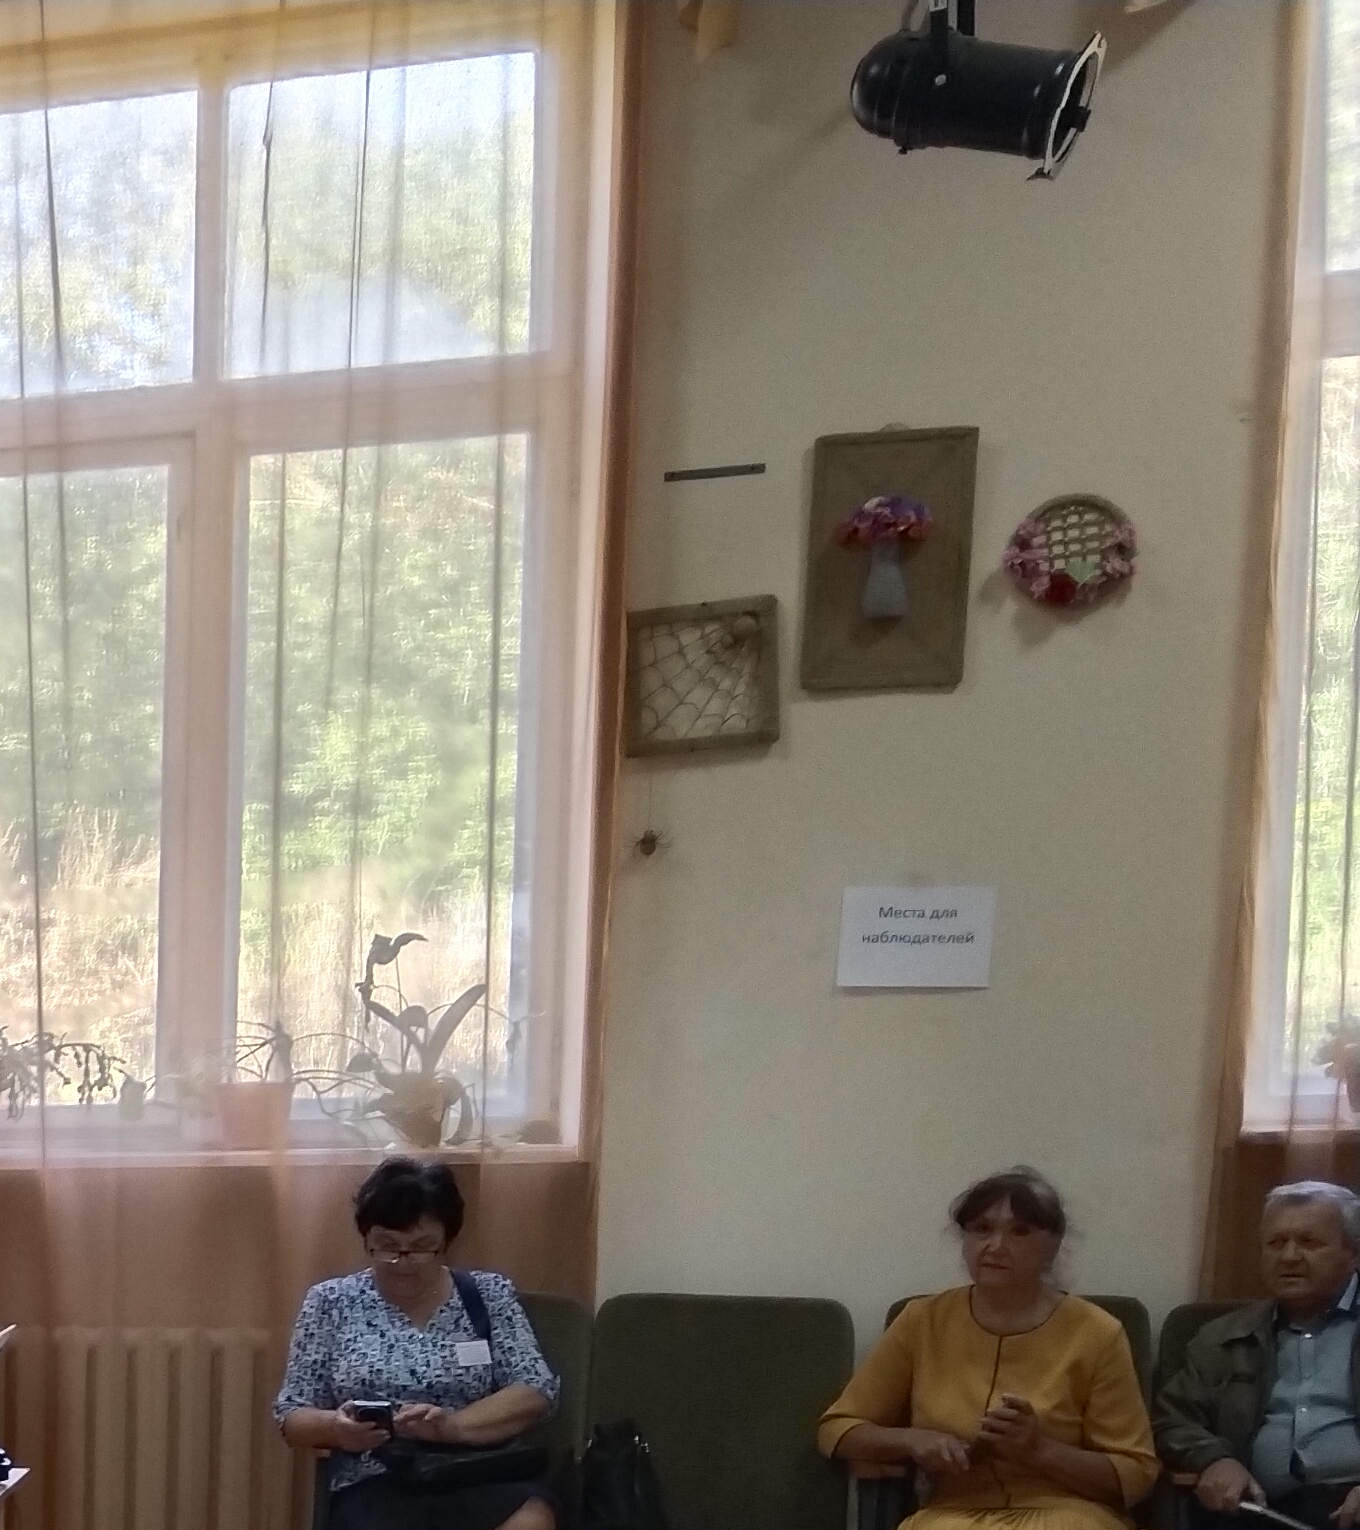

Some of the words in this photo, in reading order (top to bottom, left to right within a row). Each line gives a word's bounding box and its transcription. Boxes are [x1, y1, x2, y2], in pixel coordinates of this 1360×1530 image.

[878, 906, 925, 919] Места
[929, 907, 958, 920] для
[862, 930, 975, 946] наблюдателей
